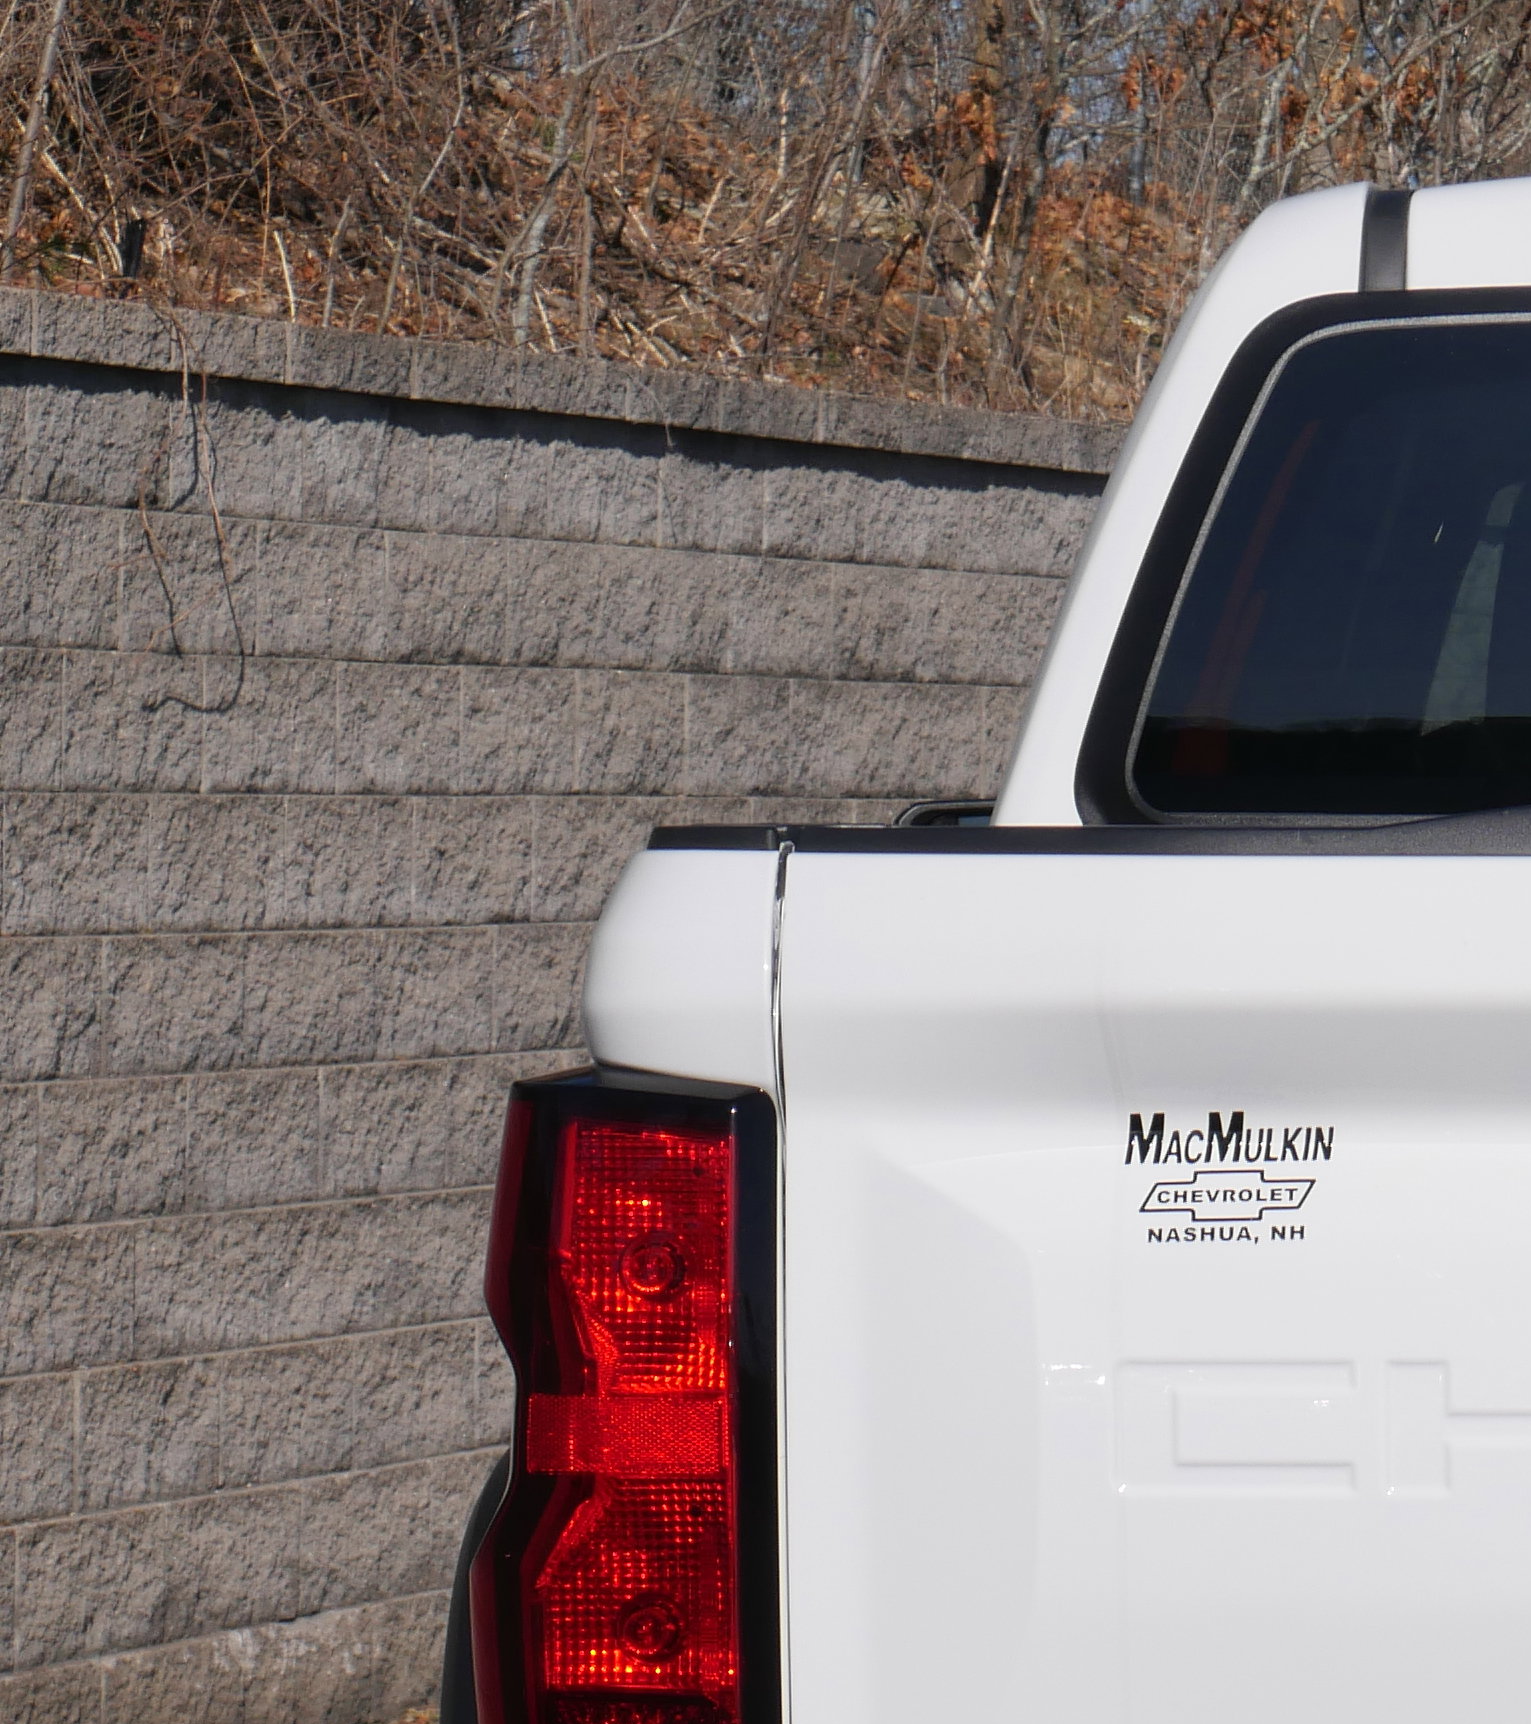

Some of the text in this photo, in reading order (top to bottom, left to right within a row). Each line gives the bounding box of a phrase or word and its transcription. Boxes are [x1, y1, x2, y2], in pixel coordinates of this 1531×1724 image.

[1156, 1187, 1299, 1204] CHEVROLET
[1147, 1225, 1306, 1245] NASHUA, NH
